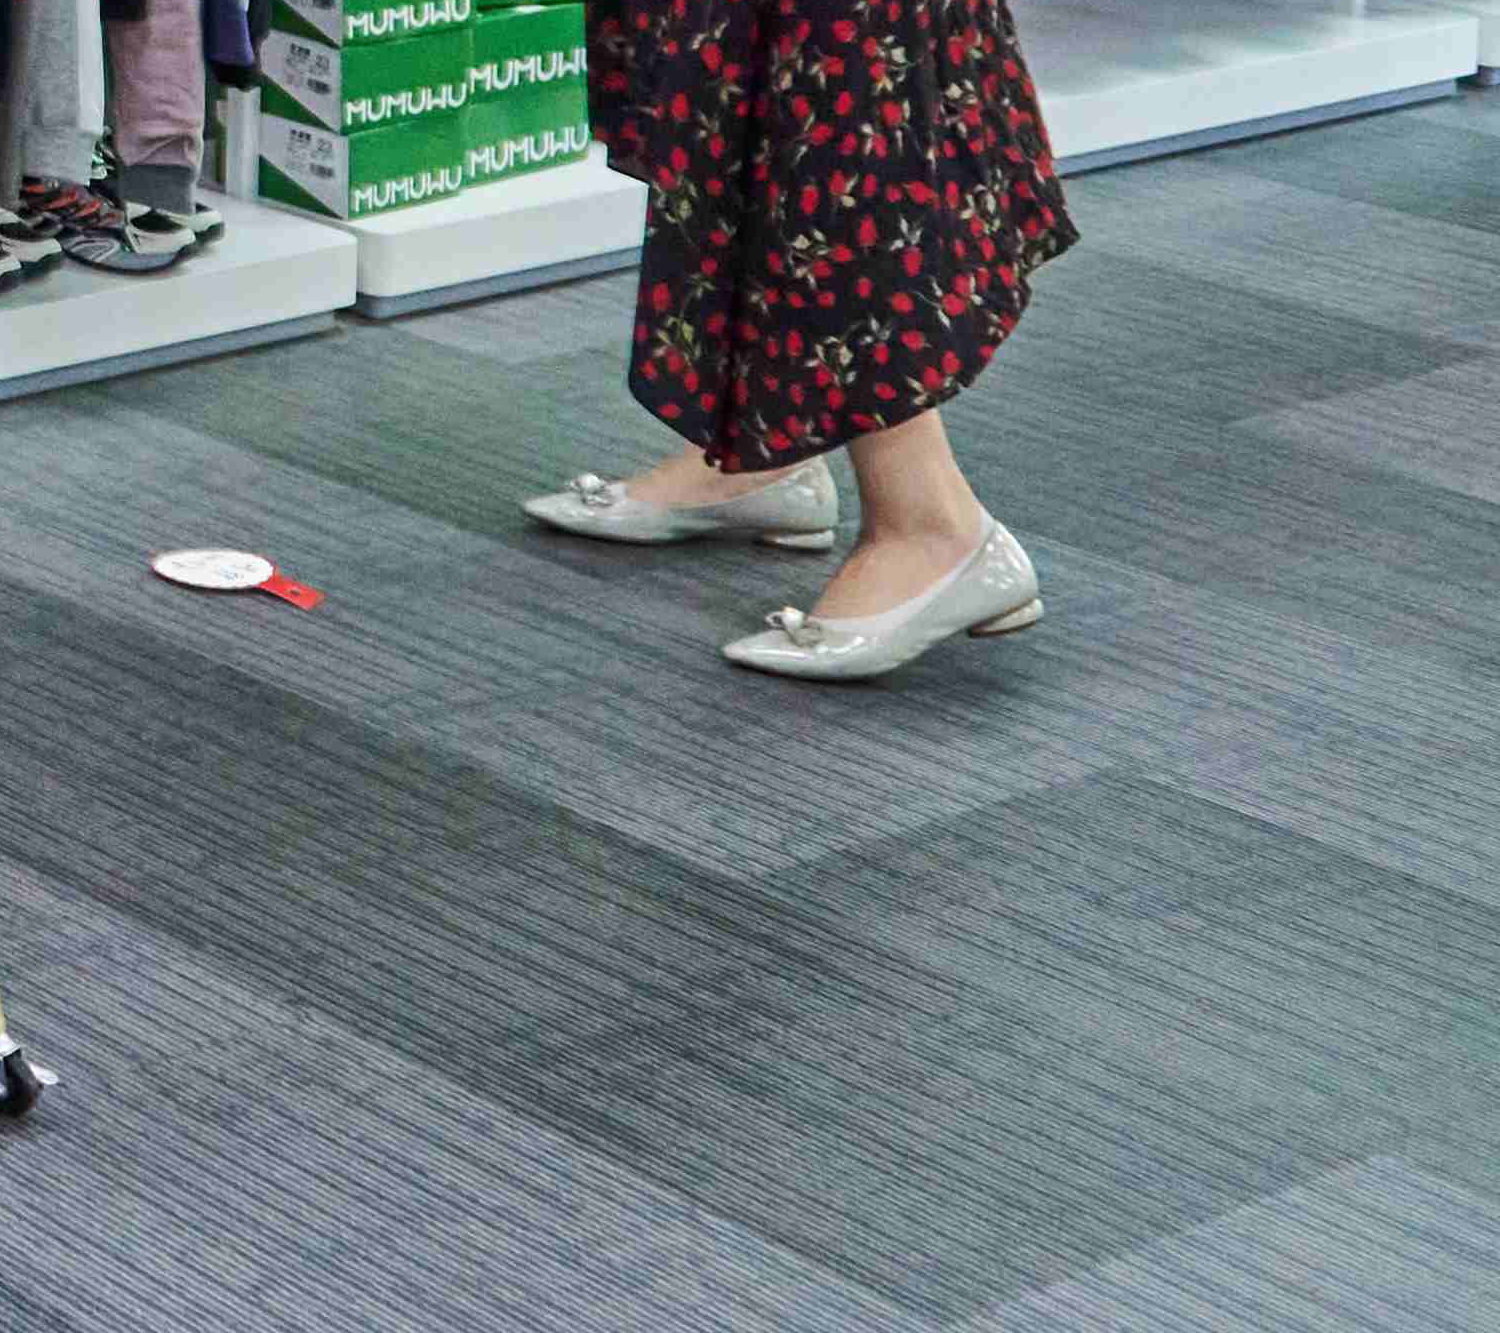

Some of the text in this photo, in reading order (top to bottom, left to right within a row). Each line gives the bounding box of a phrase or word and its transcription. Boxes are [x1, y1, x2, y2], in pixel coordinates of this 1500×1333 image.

[345, 83, 467, 125] MUMUWU
[468, 122, 590, 178] MUMUWU
[353, 165, 462, 213] MUMUWU
